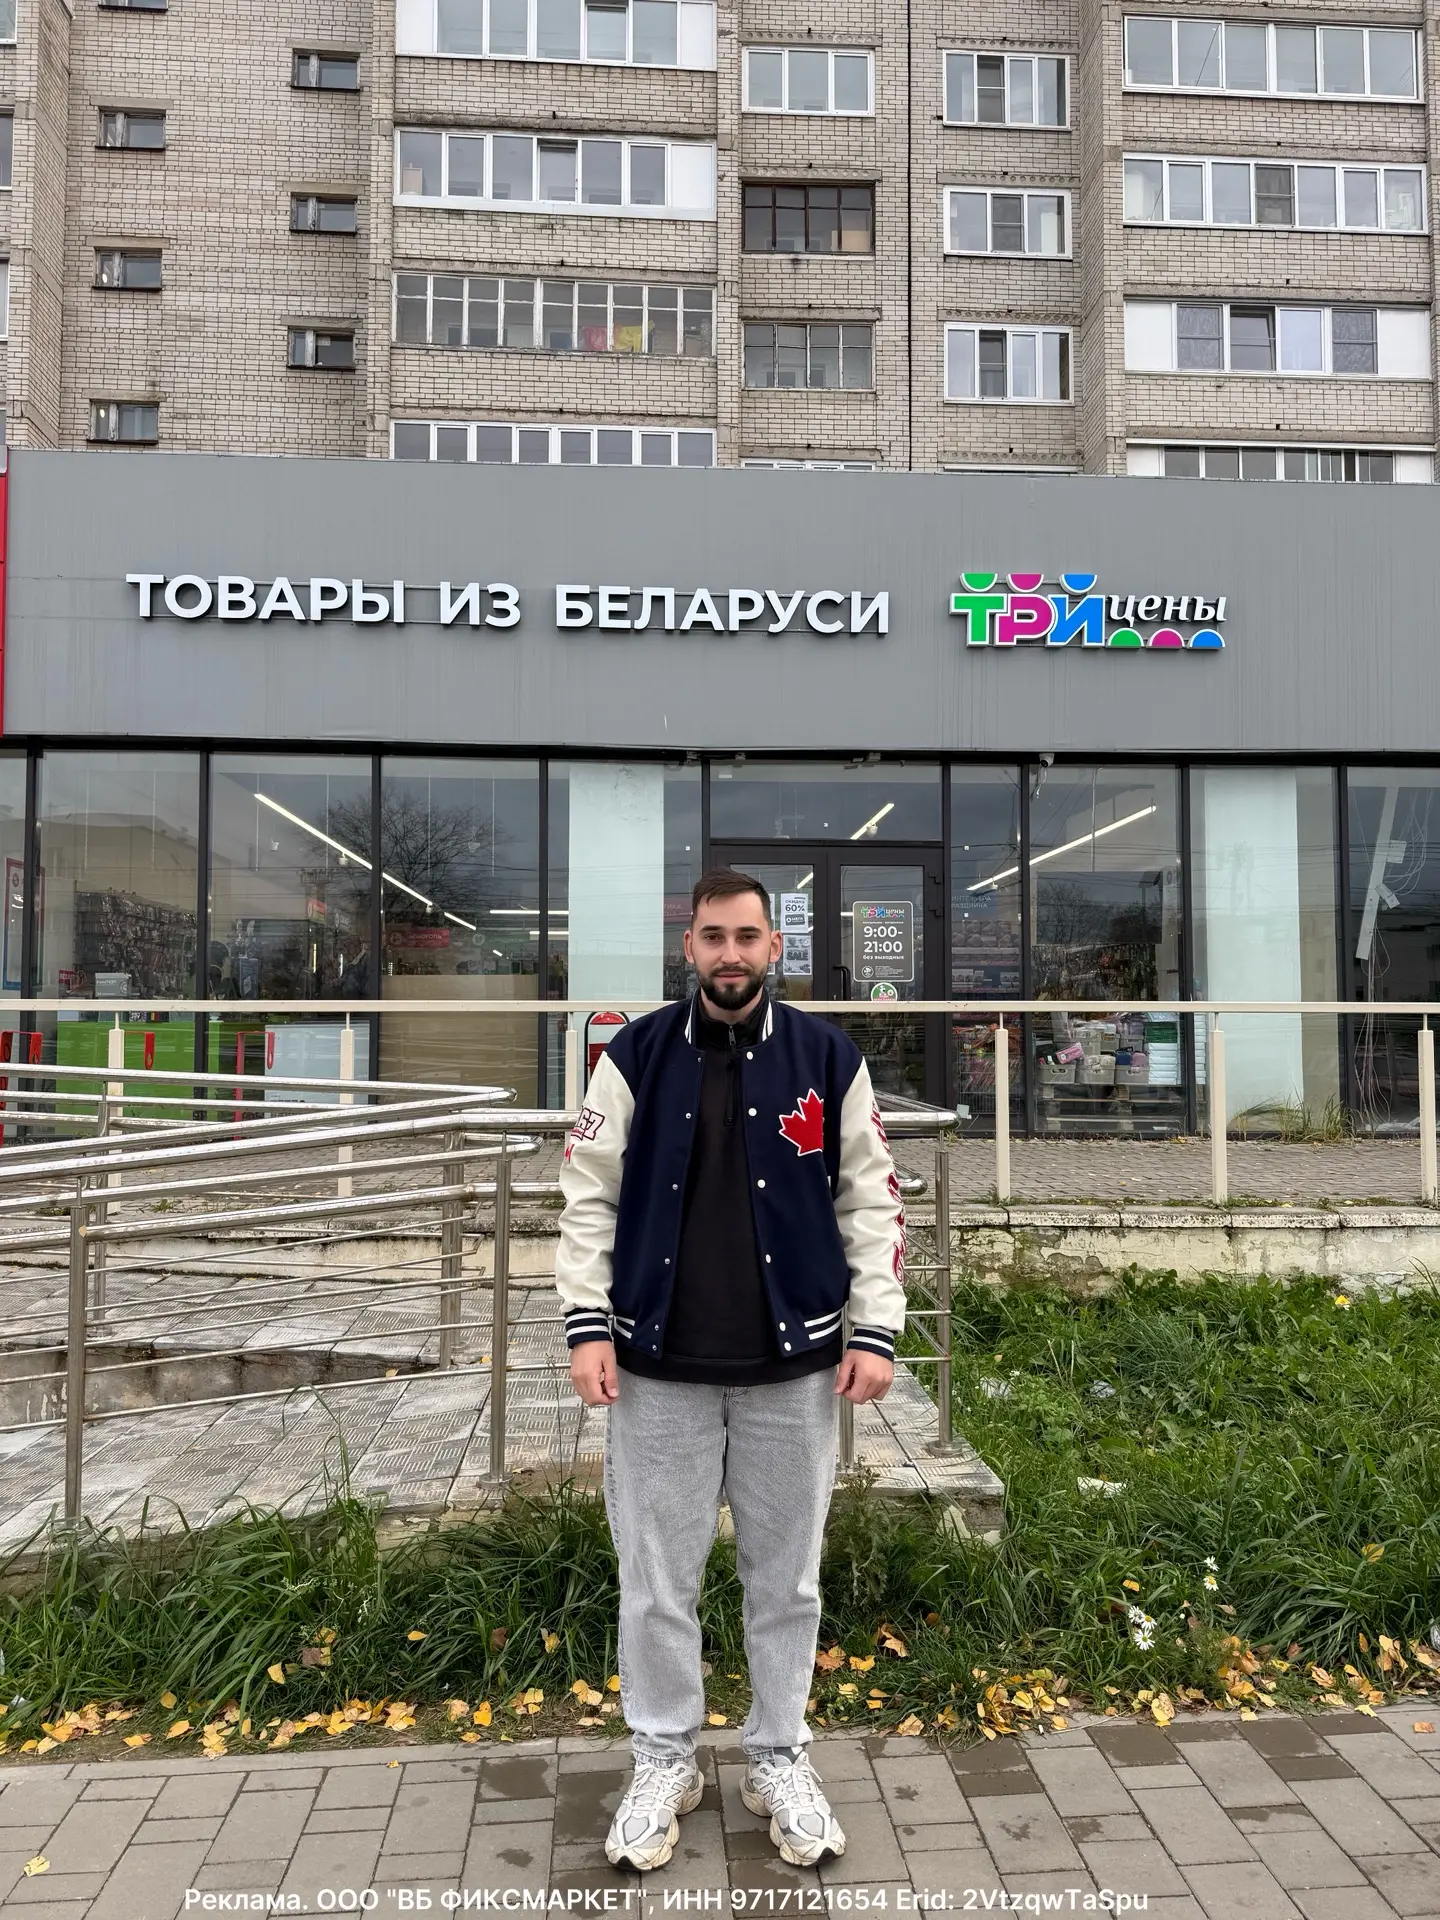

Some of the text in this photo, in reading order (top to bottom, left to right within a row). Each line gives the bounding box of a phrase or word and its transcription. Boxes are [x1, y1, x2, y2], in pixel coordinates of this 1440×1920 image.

[125, 573, 889, 635] ТОВАРЫ ИЗ БЕЛАРУСИ
[1106, 594, 1227, 627] цены
[785, 904, 806, 912] 60%
[863, 926, 903, 938] 9:00-
[863, 941, 903, 953] 21:00
[786, 951, 809, 961] SALE
[575, 1105, 606, 1141] 67
